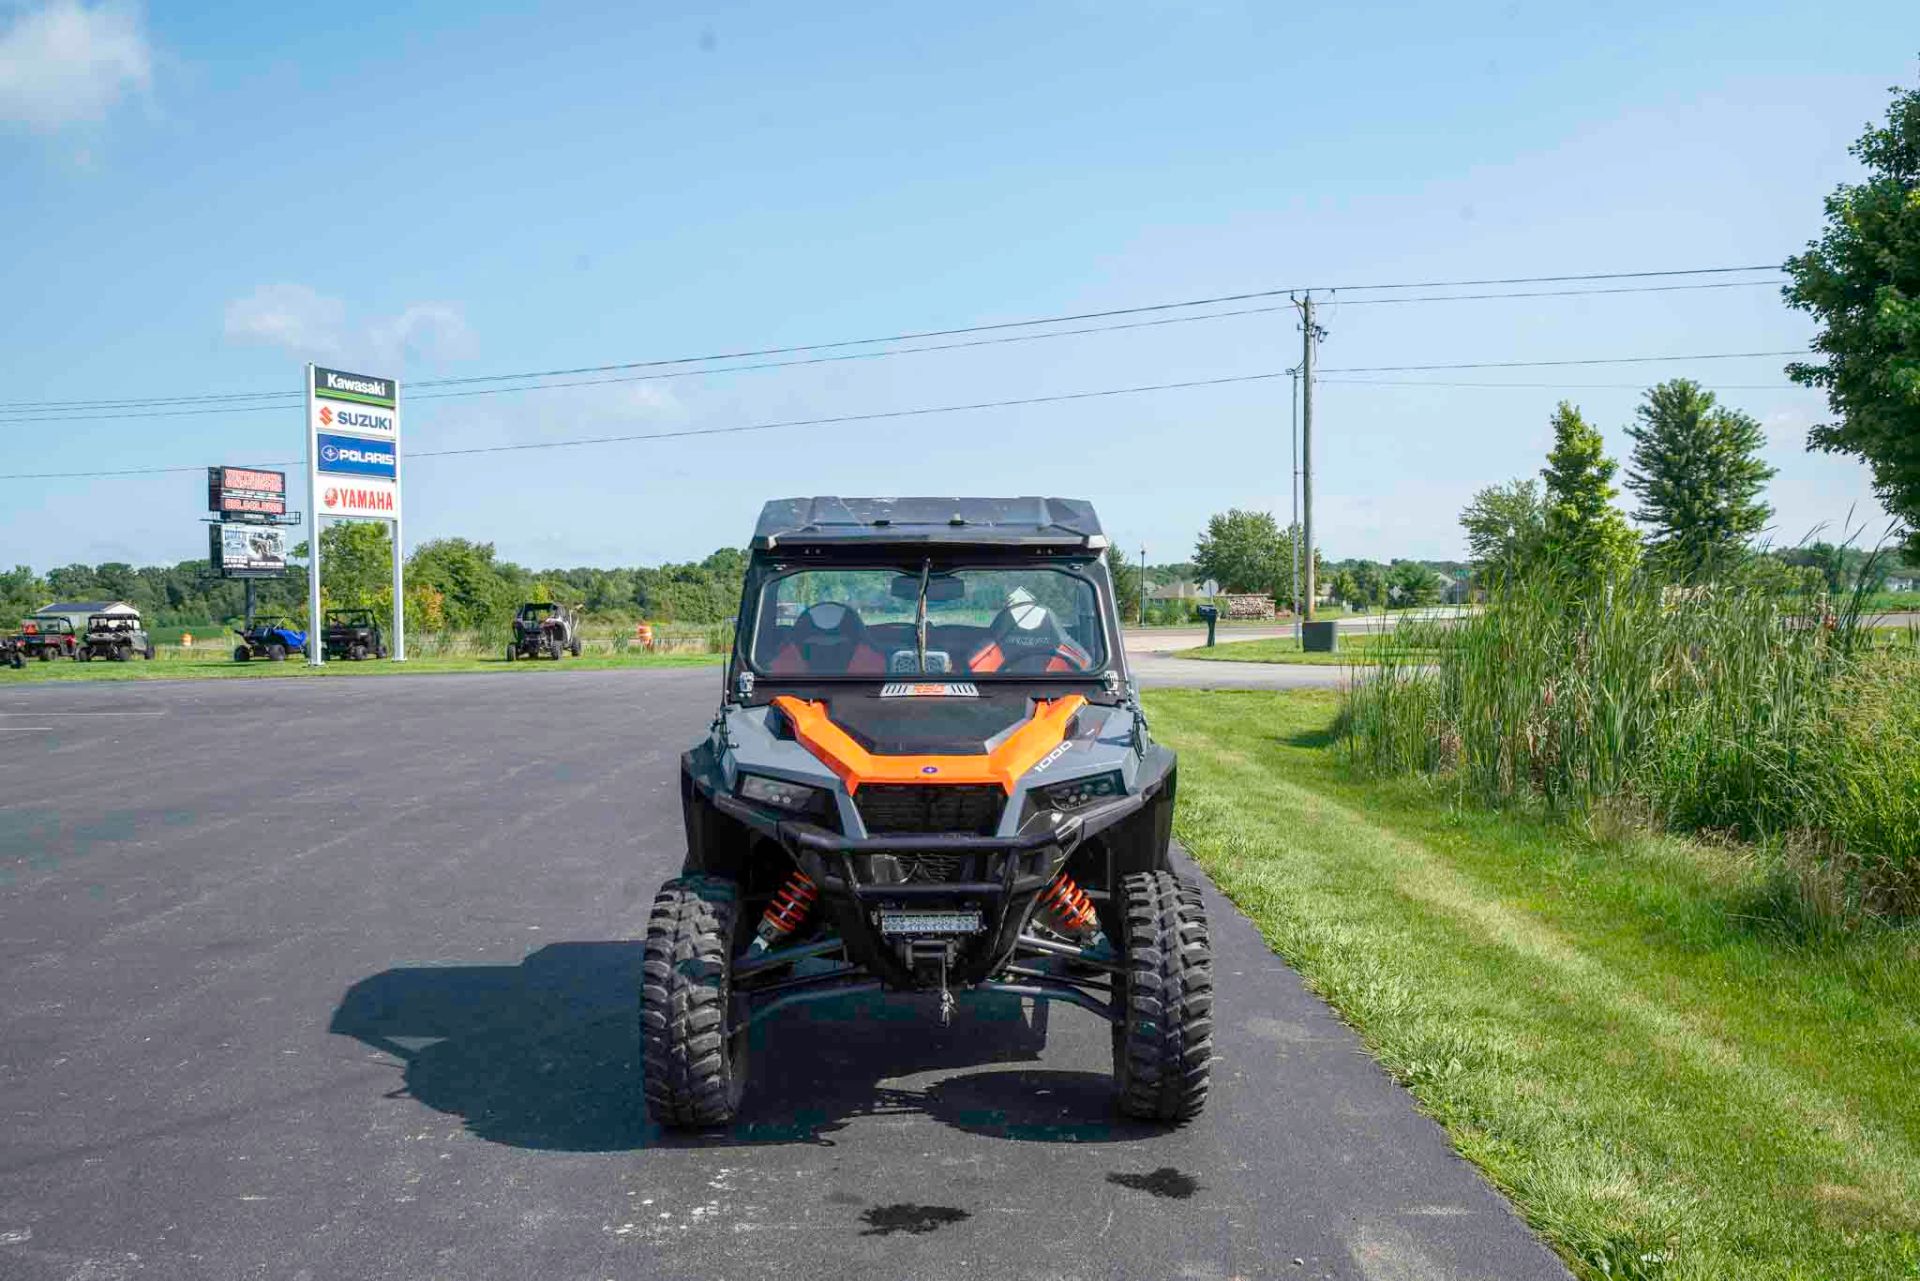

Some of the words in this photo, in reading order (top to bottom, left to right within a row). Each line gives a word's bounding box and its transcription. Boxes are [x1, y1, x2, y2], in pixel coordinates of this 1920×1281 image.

[327, 373, 385, 396] Kawasaki
[337, 411, 392, 430] SUZUKI
[339, 449, 395, 465] POLARIS
[340, 488, 393, 511] YAMAHA
[1034, 740, 1073, 772] 1000
